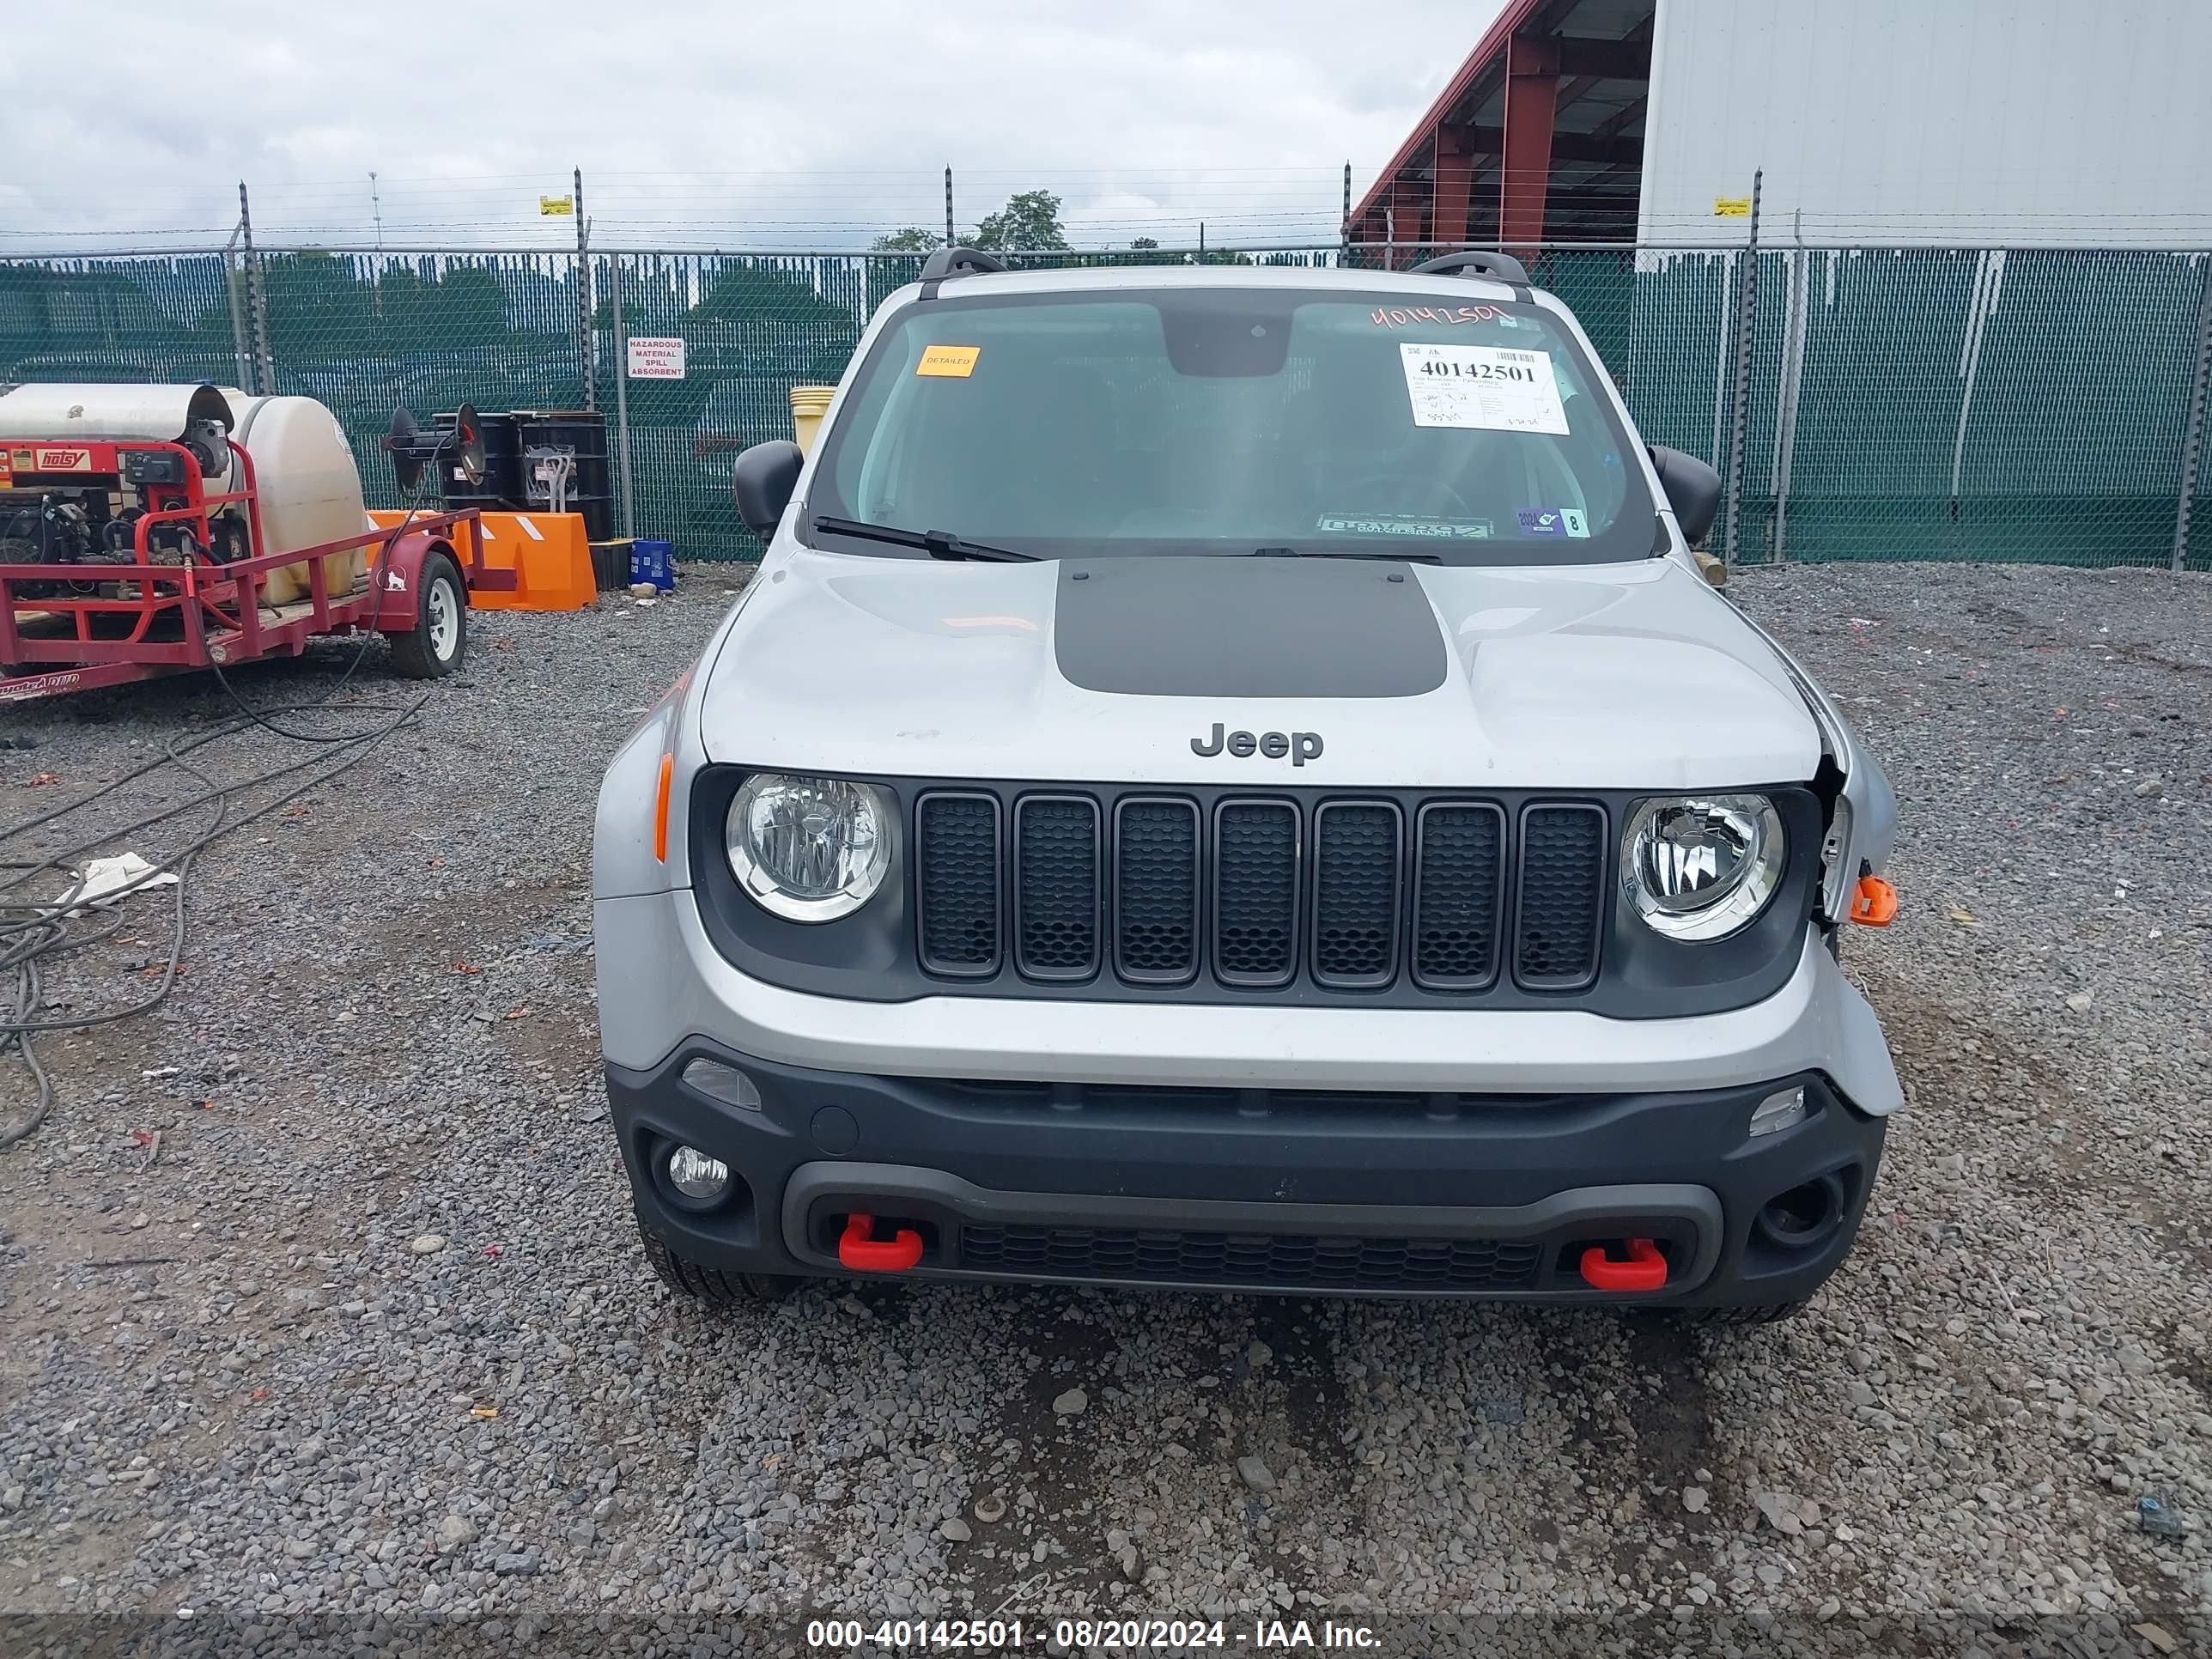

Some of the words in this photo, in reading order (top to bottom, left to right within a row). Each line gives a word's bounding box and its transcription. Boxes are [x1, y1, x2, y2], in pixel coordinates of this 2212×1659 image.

[1371, 305, 1513, 330] 40142501
[1420, 361, 1536, 383] 40142501
[41, 450, 87, 469] hotsy
[1570, 515, 1579, 532] 8
[1190, 723, 1324, 767] Jeep
